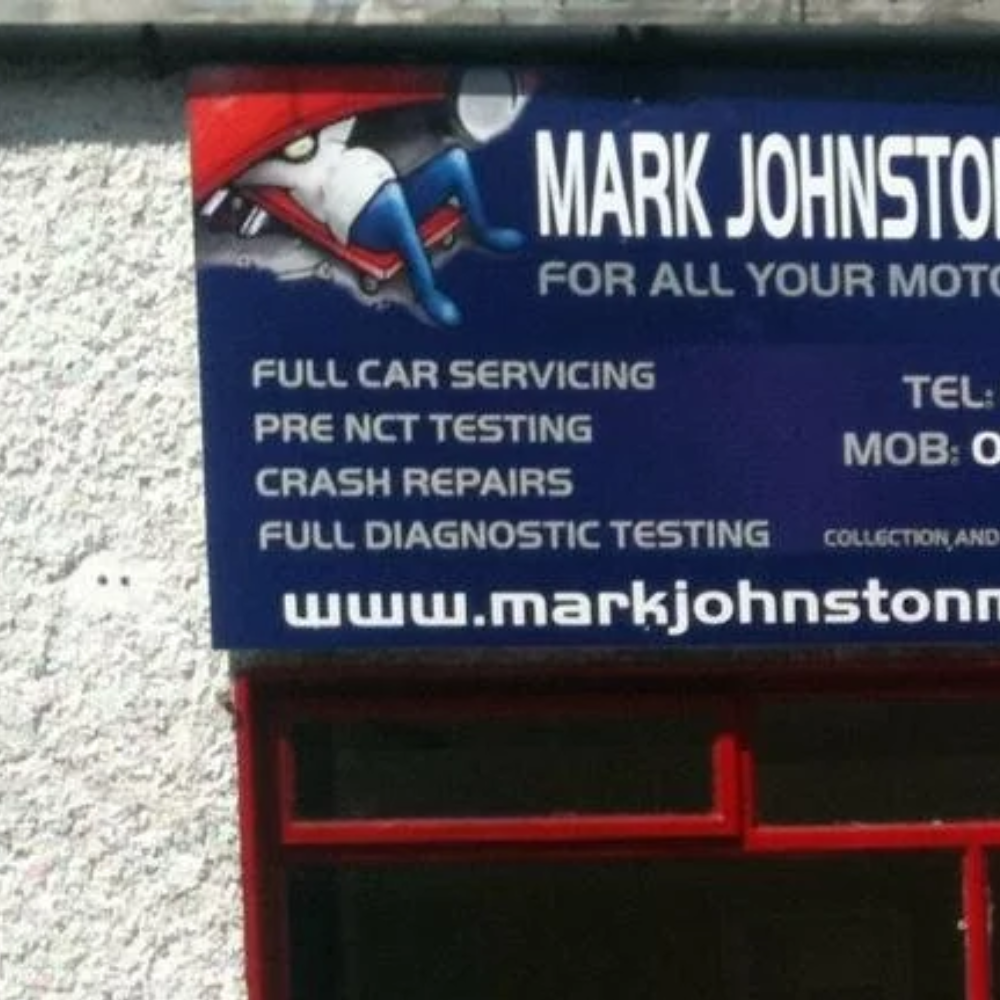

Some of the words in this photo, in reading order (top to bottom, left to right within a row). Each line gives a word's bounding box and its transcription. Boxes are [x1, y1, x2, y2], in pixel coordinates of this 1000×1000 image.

[536, 130, 711, 237] MARK
[539, 261, 636, 296] FOR
[650, 262, 734, 297] ALL
[747, 262, 874, 297] YOUR
[252, 359, 348, 389] FULL
[357, 359, 439, 389] CAR
[449, 360, 655, 390] SERVICING
[902, 375, 993, 409] TEL:
[254, 413, 334, 443] PRE
[344, 413, 420, 443] NCT
[428, 413, 593, 443] TESTING
[843, 431, 958, 466] MOB:
[255, 467, 391, 497] CRASH
[402, 467, 573, 497] REPAIRS
[259, 520, 355, 550] FULL
[365, 520, 600, 550] DIAGNOSTIC
[609, 519, 770, 549] TESTING
[953, 528, 1000, 547] AND
